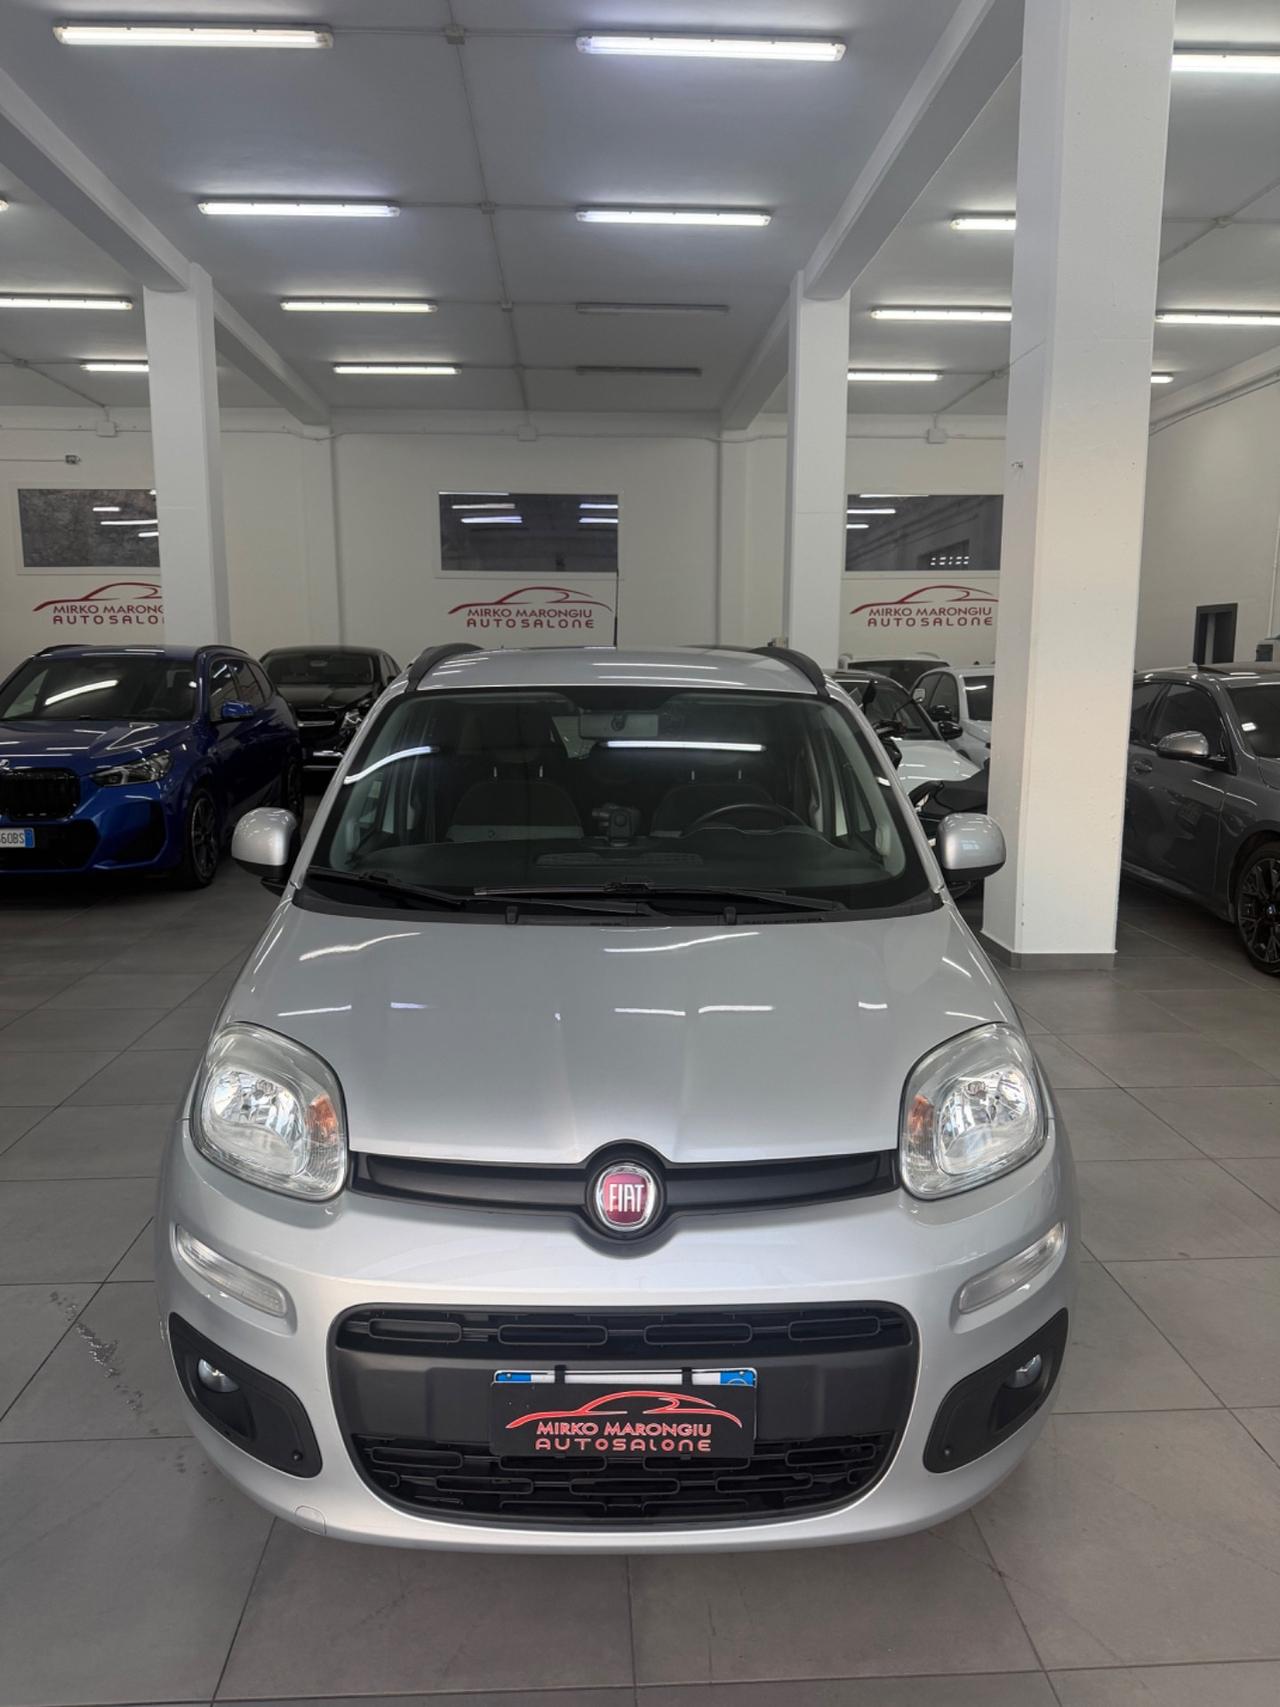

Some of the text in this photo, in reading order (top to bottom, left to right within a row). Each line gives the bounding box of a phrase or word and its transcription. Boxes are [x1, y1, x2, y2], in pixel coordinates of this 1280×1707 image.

[53, 604, 99, 614] MIRKO
[467, 608, 592, 618] MIRKO MARONGIU
[868, 606, 992, 617] MIRKO MARONGIU
[53, 615, 165, 625] AUTOSALO
[466, 618, 595, 629] AUTOSALONE
[867, 617, 993, 627] AUTOSALONE
[0, 832, 25, 844] 60BS
[609, 1183, 645, 1213] FIAT
[536, 1421, 712, 1437] MIRKO MARONGIU
[535, 1437, 712, 1452] AUTOSALONE
